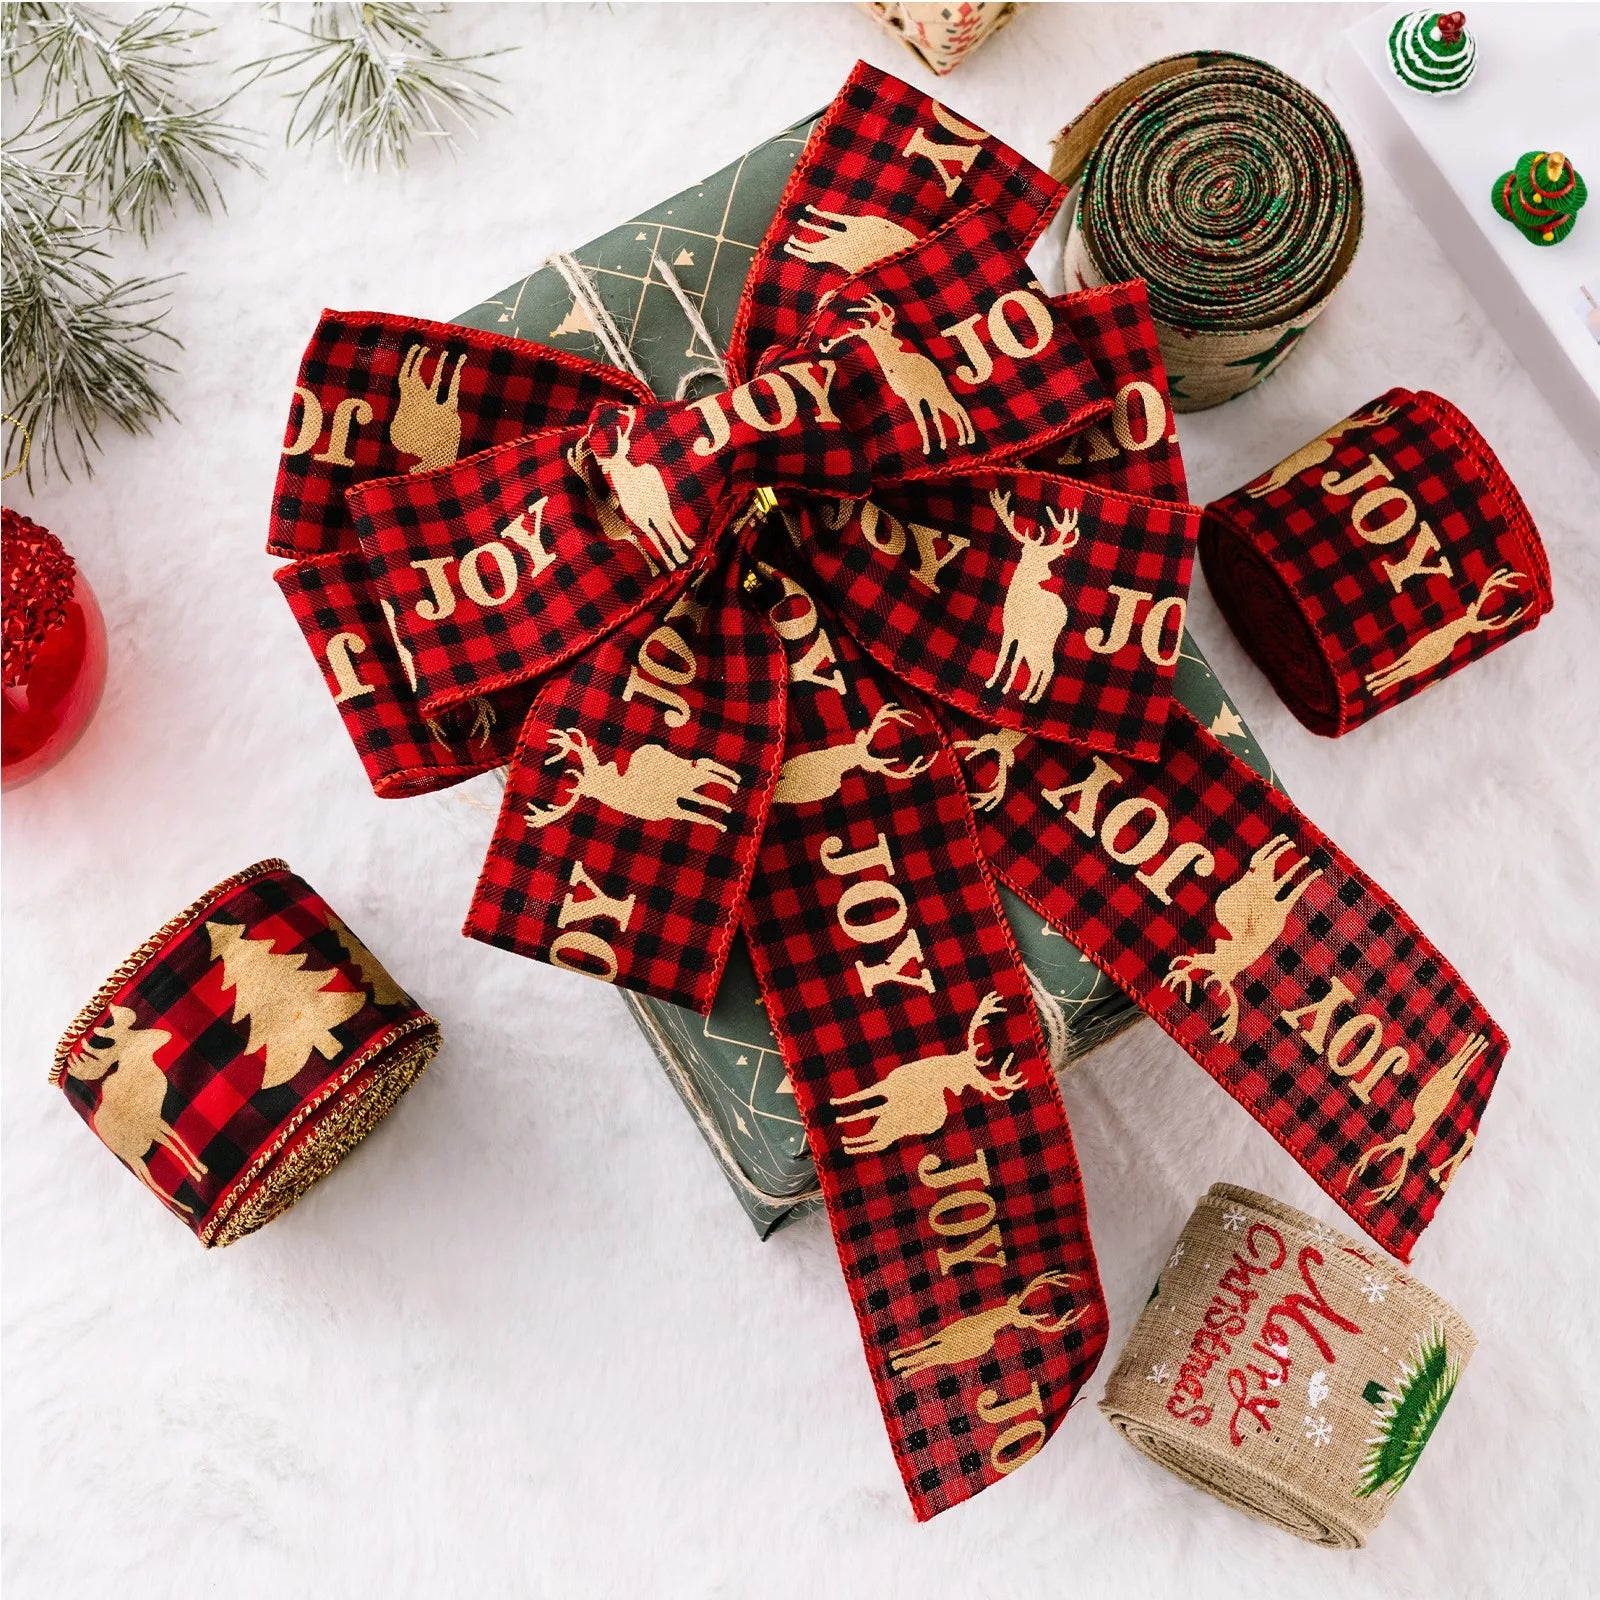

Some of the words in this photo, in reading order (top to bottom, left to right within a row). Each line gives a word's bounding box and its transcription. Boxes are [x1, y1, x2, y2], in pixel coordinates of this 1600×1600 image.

[940, 281, 1053, 384] JO
[684, 358, 842, 457] JOY
[411, 497, 557, 621] JOY
[1321, 453, 1453, 593] JOY
[1041, 755, 1215, 906] JOY
[819, 833, 936, 998] JOY
[1281, 976, 1410, 1104] JOY
[918, 1148, 1007, 1276] JOY
[1228, 1246, 1363, 1447] Merry
